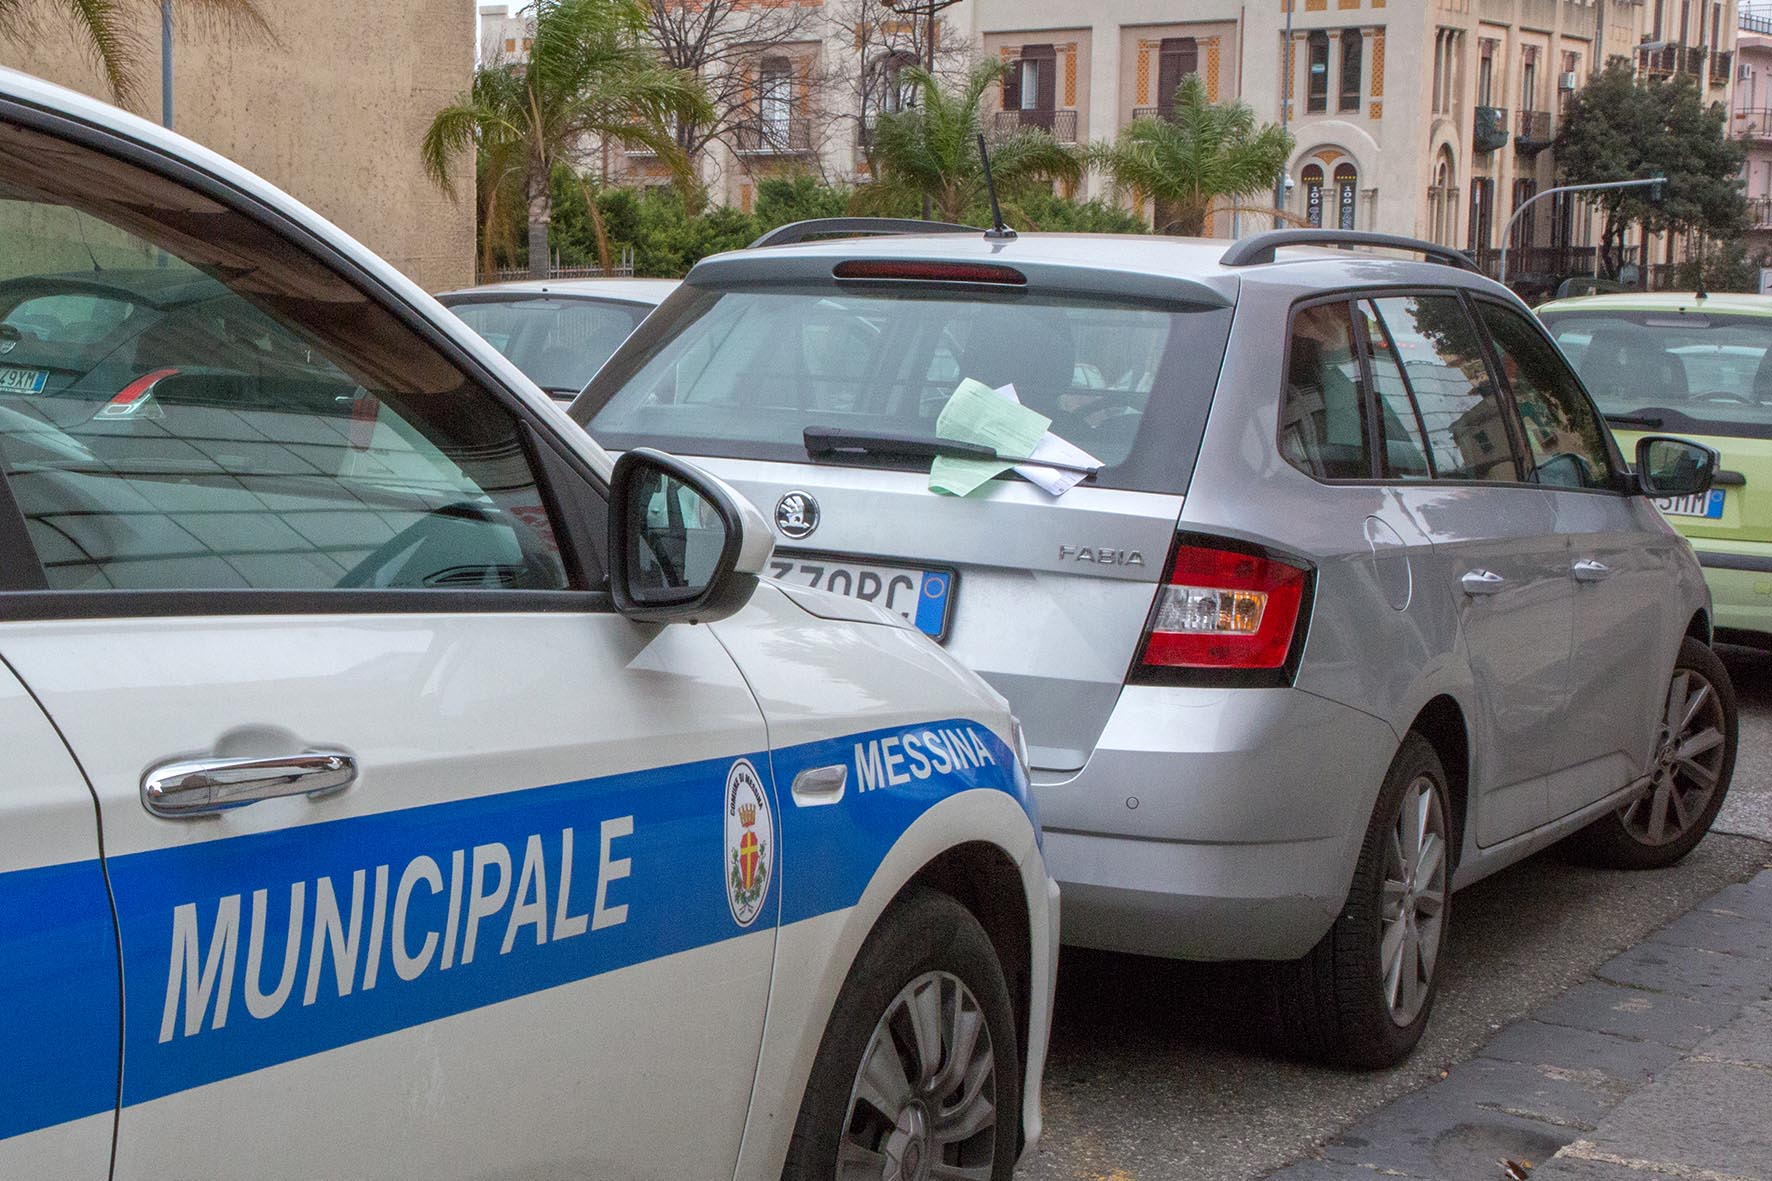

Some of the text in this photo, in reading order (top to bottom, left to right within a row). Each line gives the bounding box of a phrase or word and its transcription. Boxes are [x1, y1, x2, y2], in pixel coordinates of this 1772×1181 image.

[1059, 544, 1145, 567] FABIA
[854, 727, 996, 793] MESSINA
[158, 815, 634, 1044] MUNICIPALE
